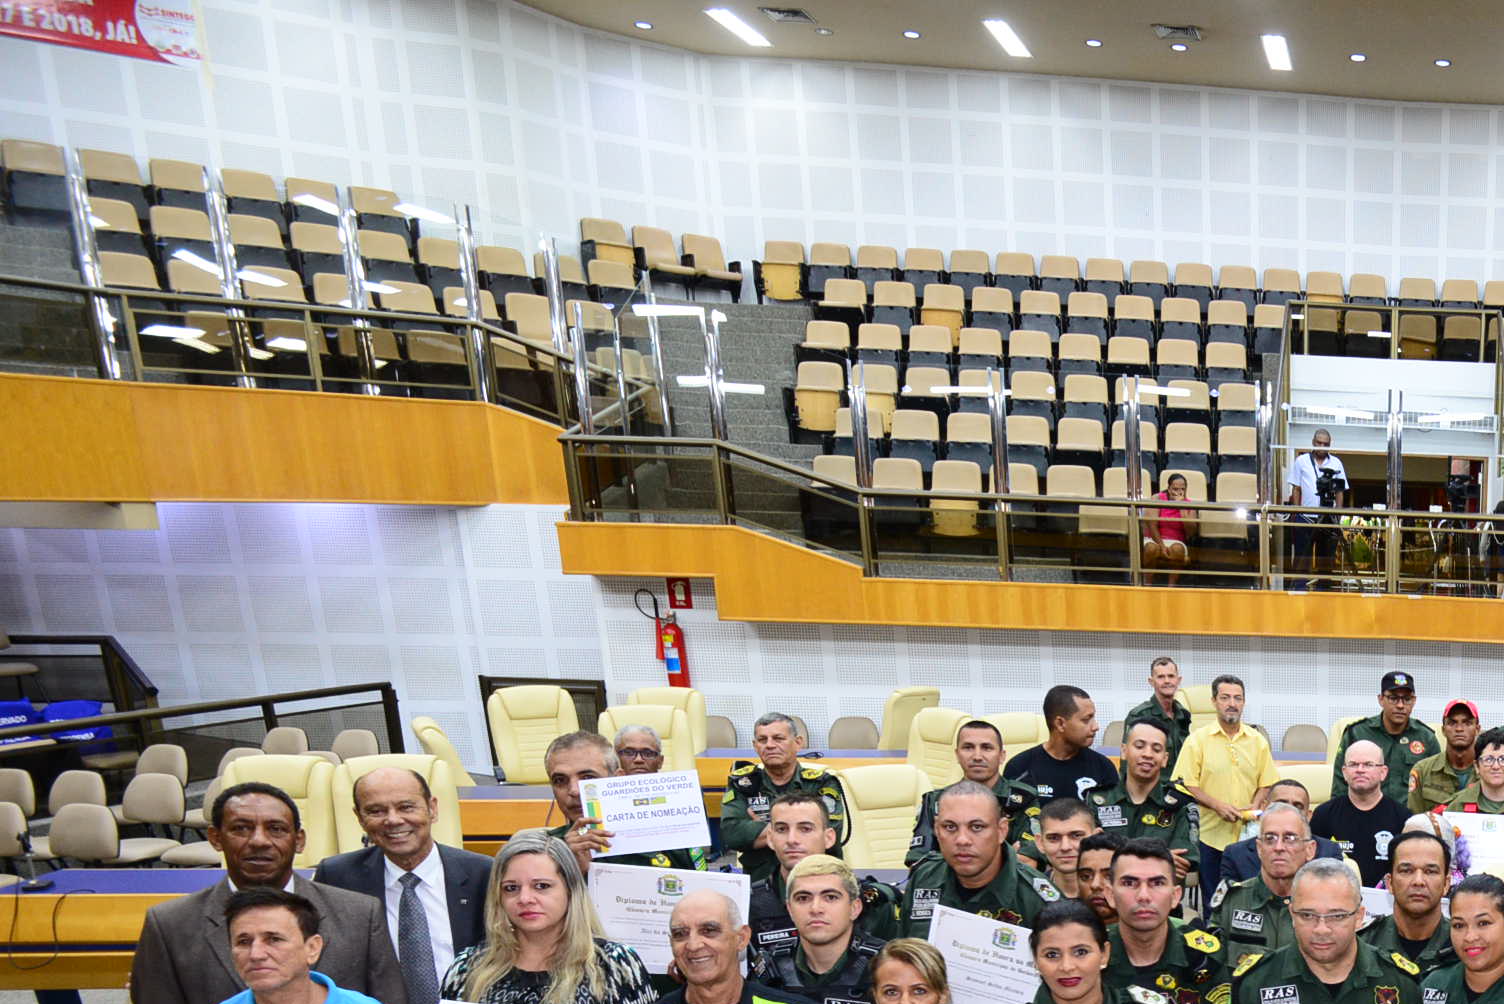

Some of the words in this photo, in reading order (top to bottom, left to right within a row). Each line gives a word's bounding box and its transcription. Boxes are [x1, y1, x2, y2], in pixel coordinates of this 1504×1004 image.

[21, 7, 35, 27] E
[37, 9, 100, 40] 2018,
[106, 19, 137, 44] JÁ!
[607, 813, 635, 822] CARTA
[638, 811, 649, 819] DE
[651, 806, 700, 817] NOMEAÇÃO
[916, 890, 938, 898] RAS
[1235, 912, 1260, 922] RAS
[1264, 986, 1294, 999] RAS
